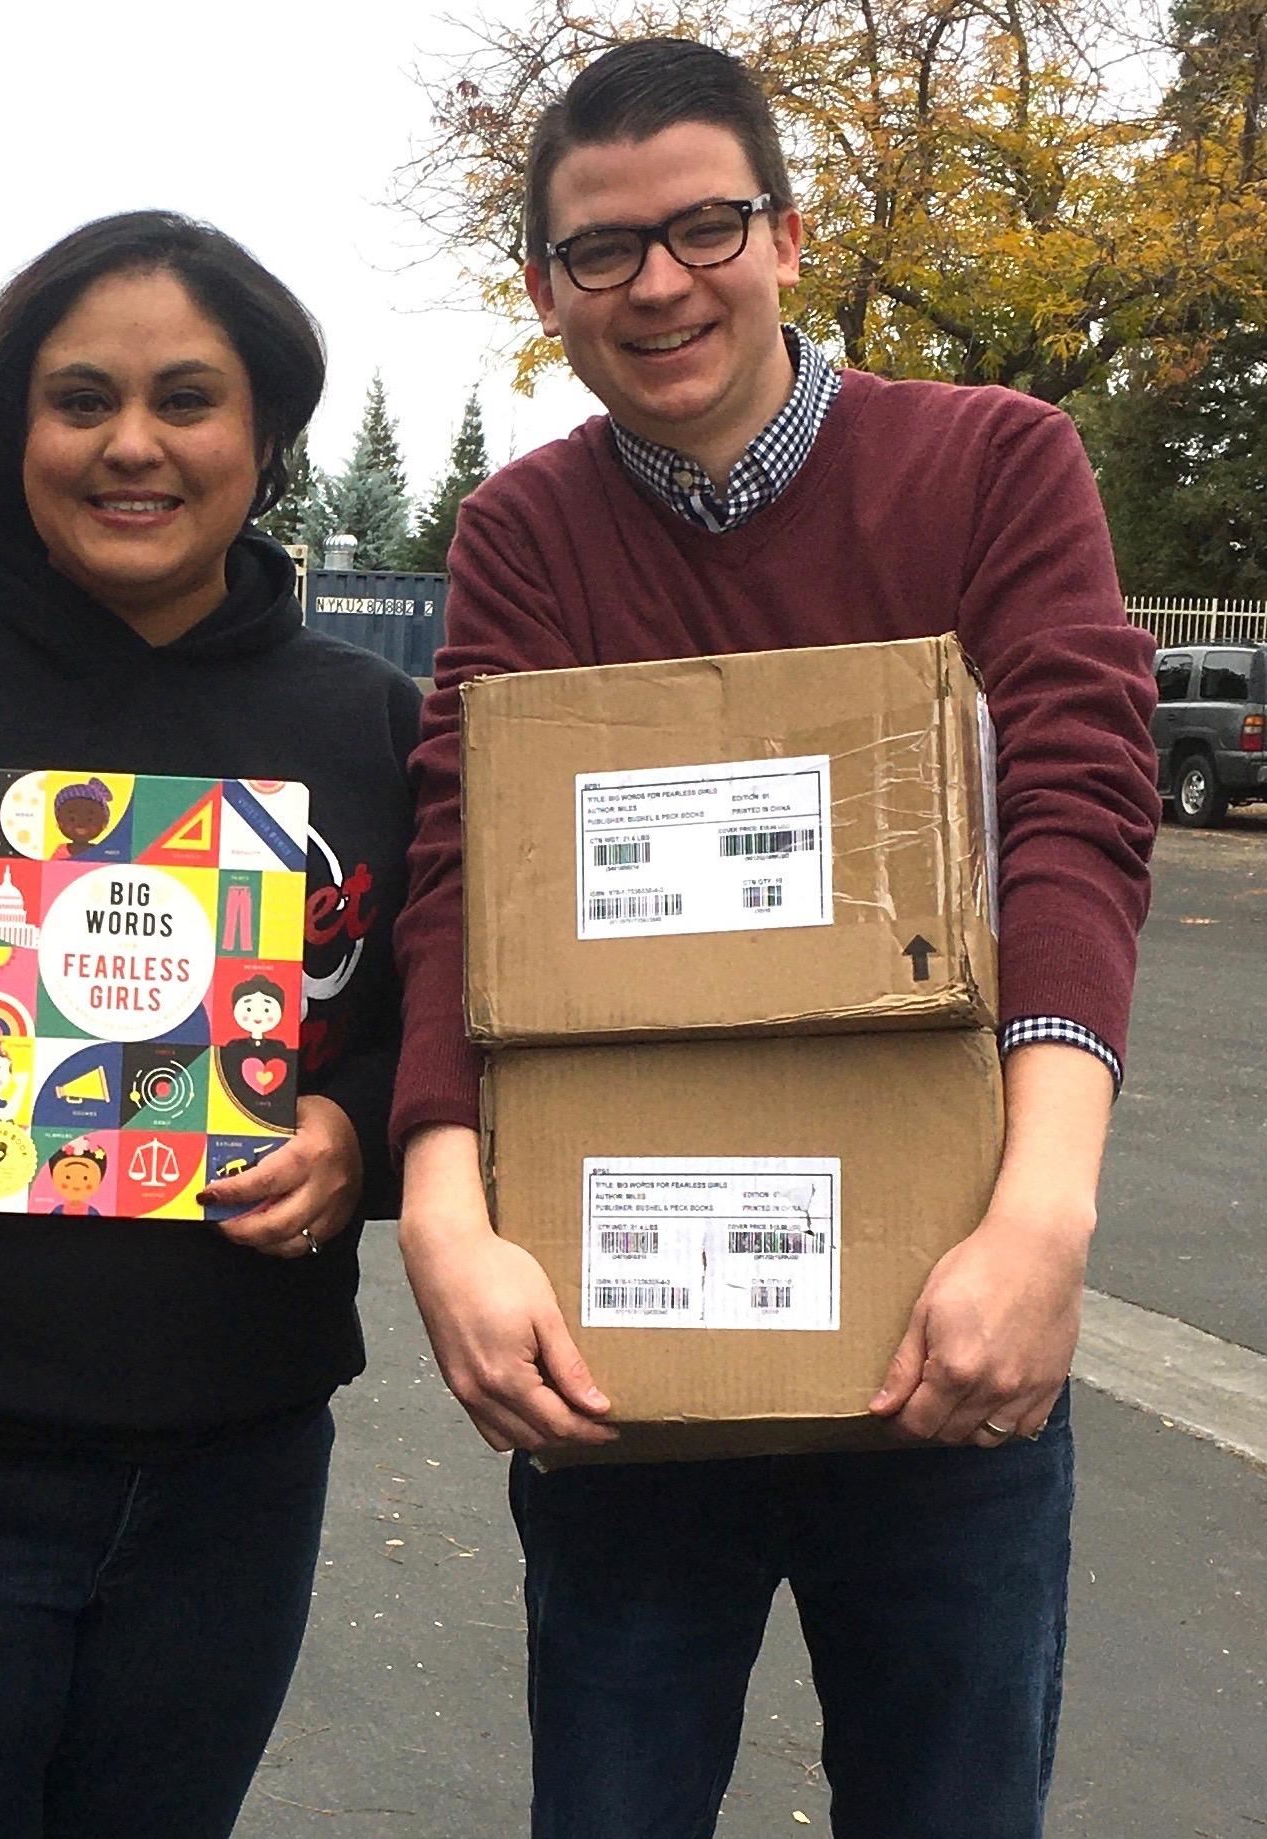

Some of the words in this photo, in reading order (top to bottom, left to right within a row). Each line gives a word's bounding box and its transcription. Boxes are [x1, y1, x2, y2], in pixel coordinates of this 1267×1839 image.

[425, 601, 433, 615] 2
[110, 881, 151, 907] BIG
[86, 910, 173, 938] WORDS
[63, 953, 190, 982] FEARLESS
[90, 985, 161, 1012] GIRLS
